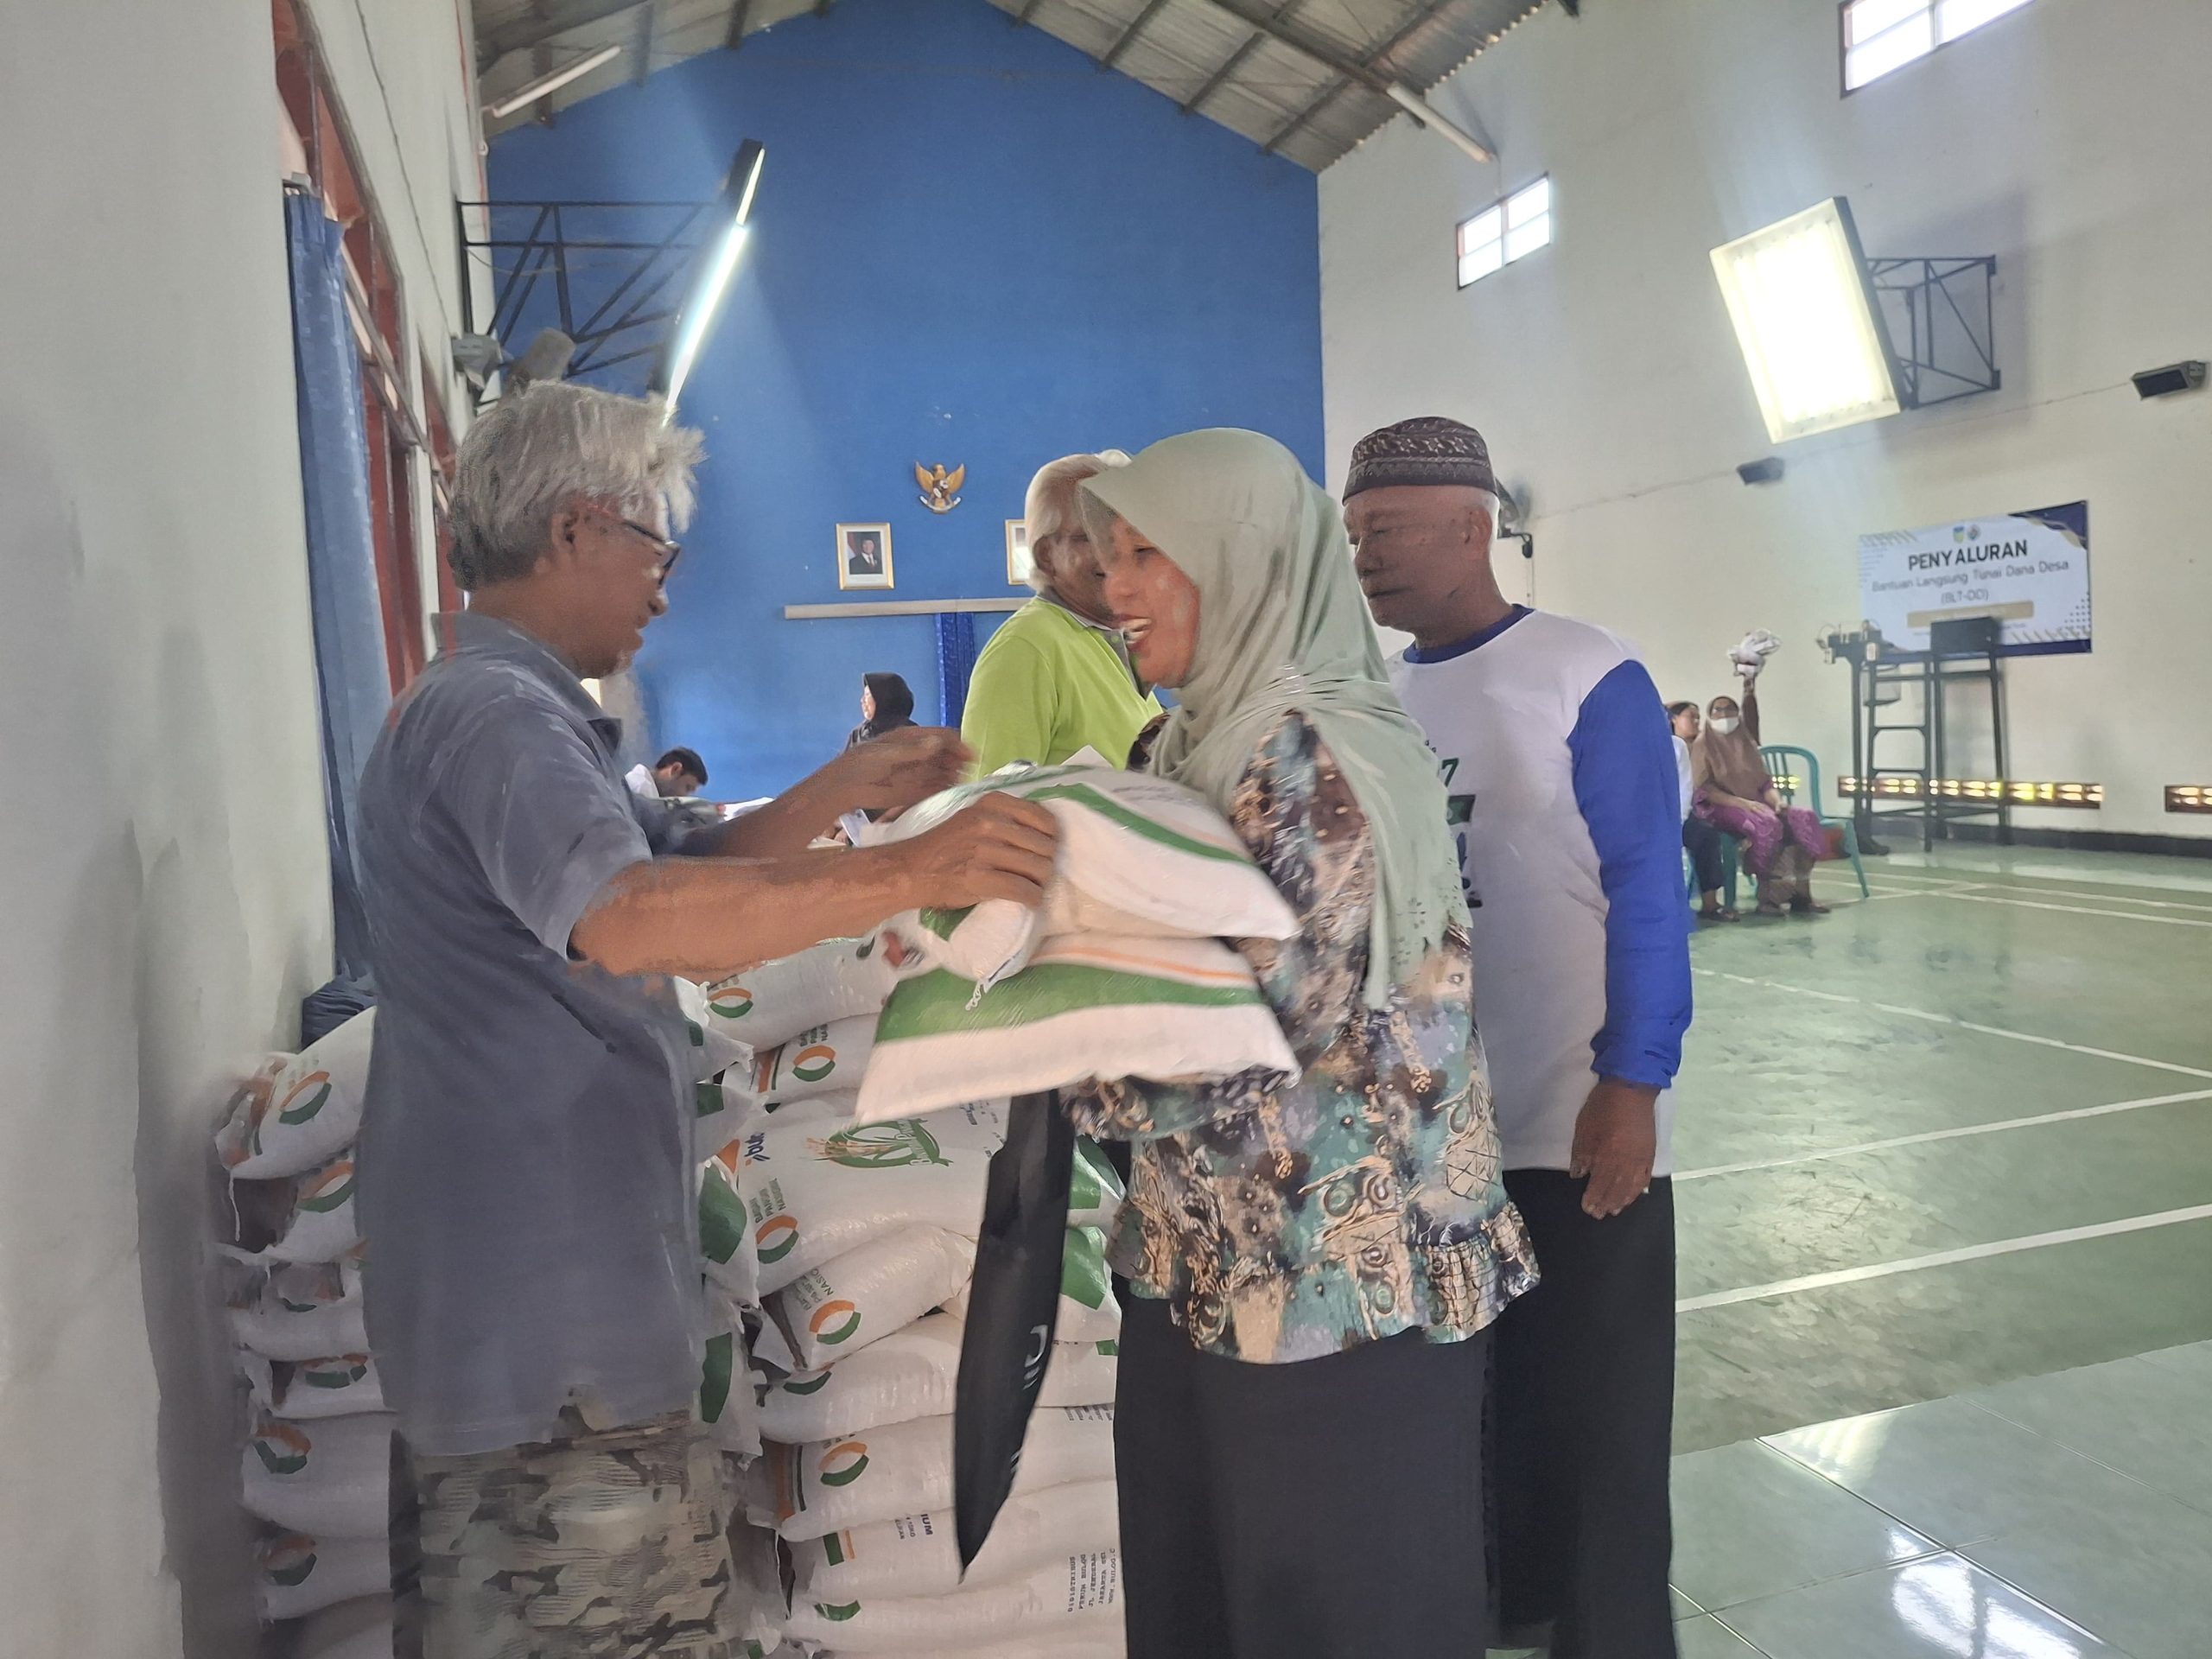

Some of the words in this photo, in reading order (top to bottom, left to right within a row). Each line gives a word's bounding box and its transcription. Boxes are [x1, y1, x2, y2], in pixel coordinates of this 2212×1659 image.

[1908, 539, 2027, 571] PENYALURAN
[2005, 564, 2035, 577] Dana
[2039, 560, 2069, 574] Desa
